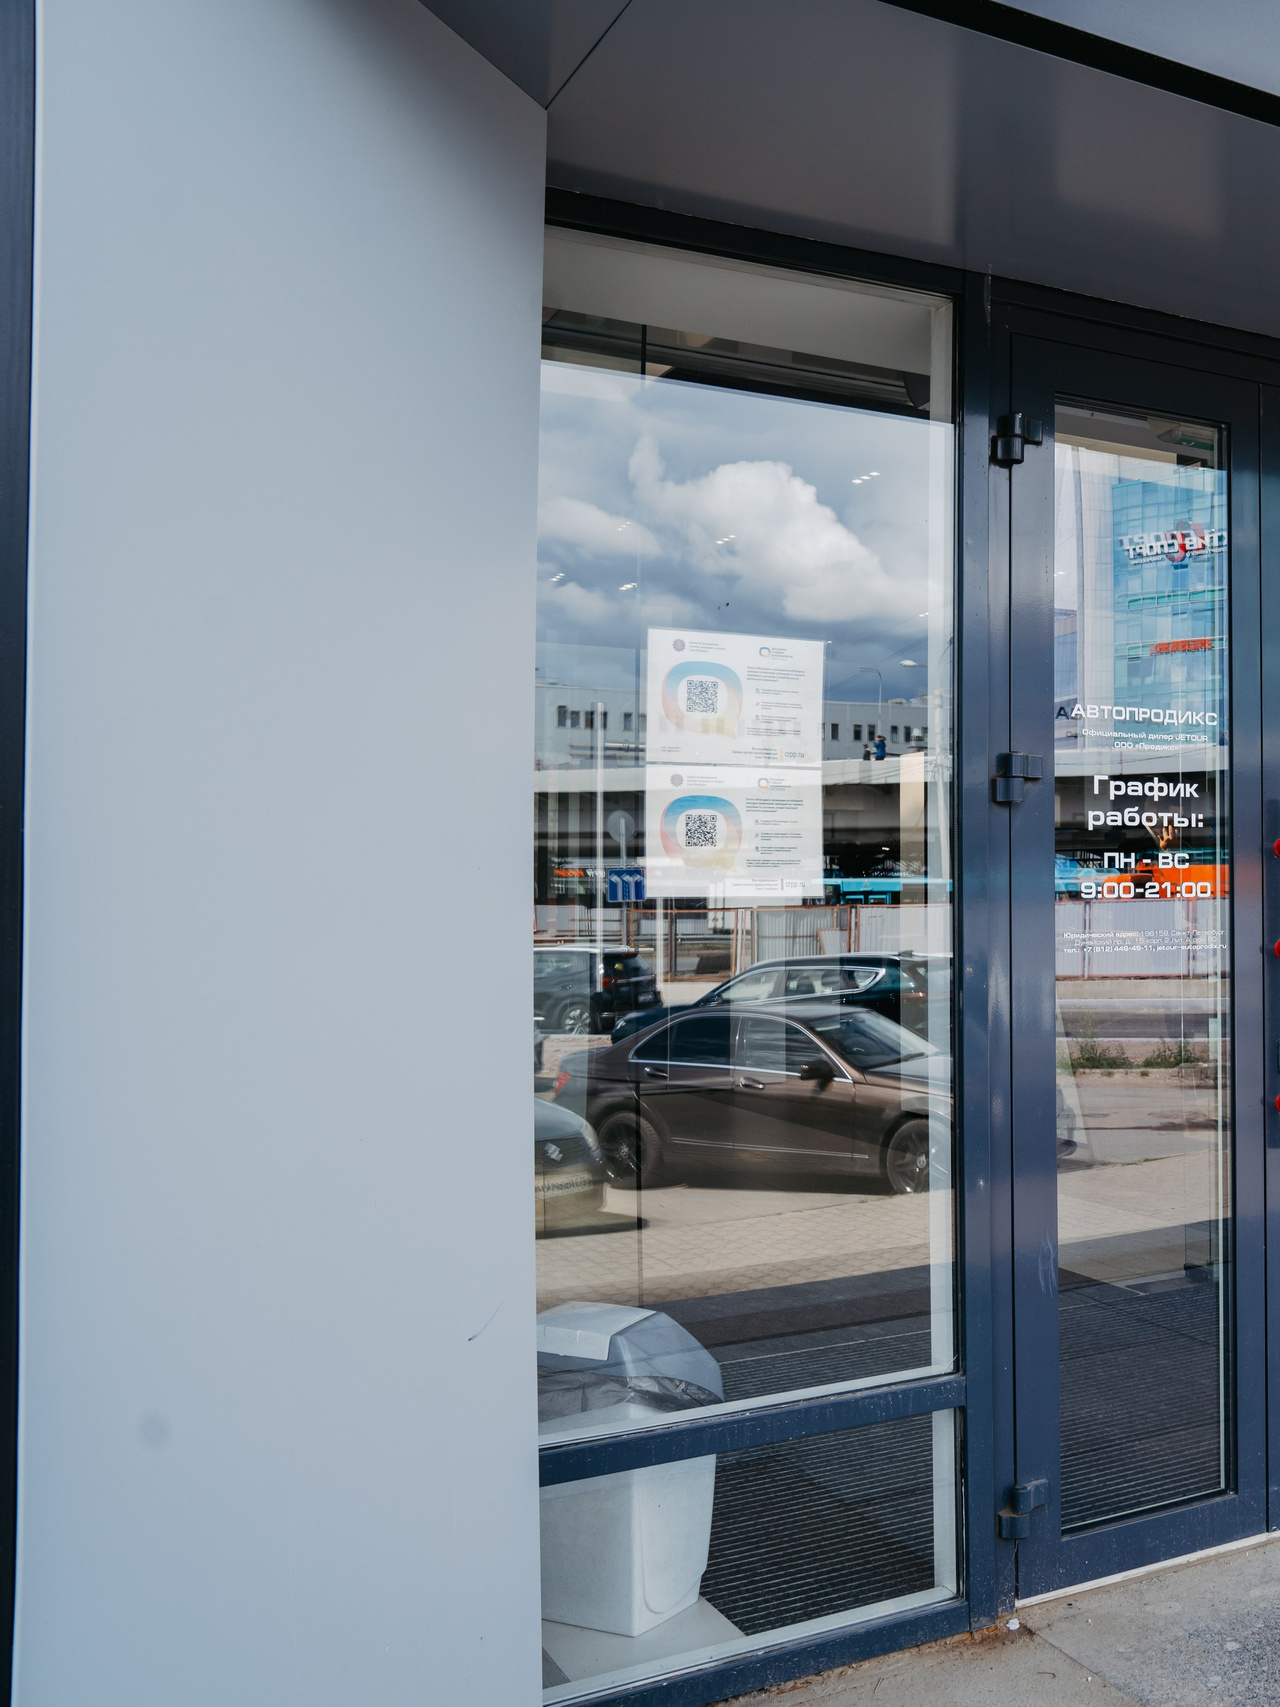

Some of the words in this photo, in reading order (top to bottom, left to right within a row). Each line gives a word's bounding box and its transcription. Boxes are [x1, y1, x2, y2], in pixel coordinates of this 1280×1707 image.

[1070, 703, 1218, 726] АВТОПРОДИКС
[1082, 728, 1146, 740] Официальный
[1148, 733, 1173, 741] дилер
[1175, 734, 1208, 742] JETOUR
[1114, 741, 1133, 749] ООО
[1135, 743, 1179, 751] «Продикс»
[1093, 774, 1199, 802] График
[1087, 806, 1204, 831] работы:
[1103, 852, 1136, 869] ПН
[1158, 853, 1190, 869] ВС
[1080, 881, 1211, 899] 9:00-21:00
[1063, 931, 1114, 939] Юридический
[1157, 944, 1227, 952] jetour-autoprodix.ru
